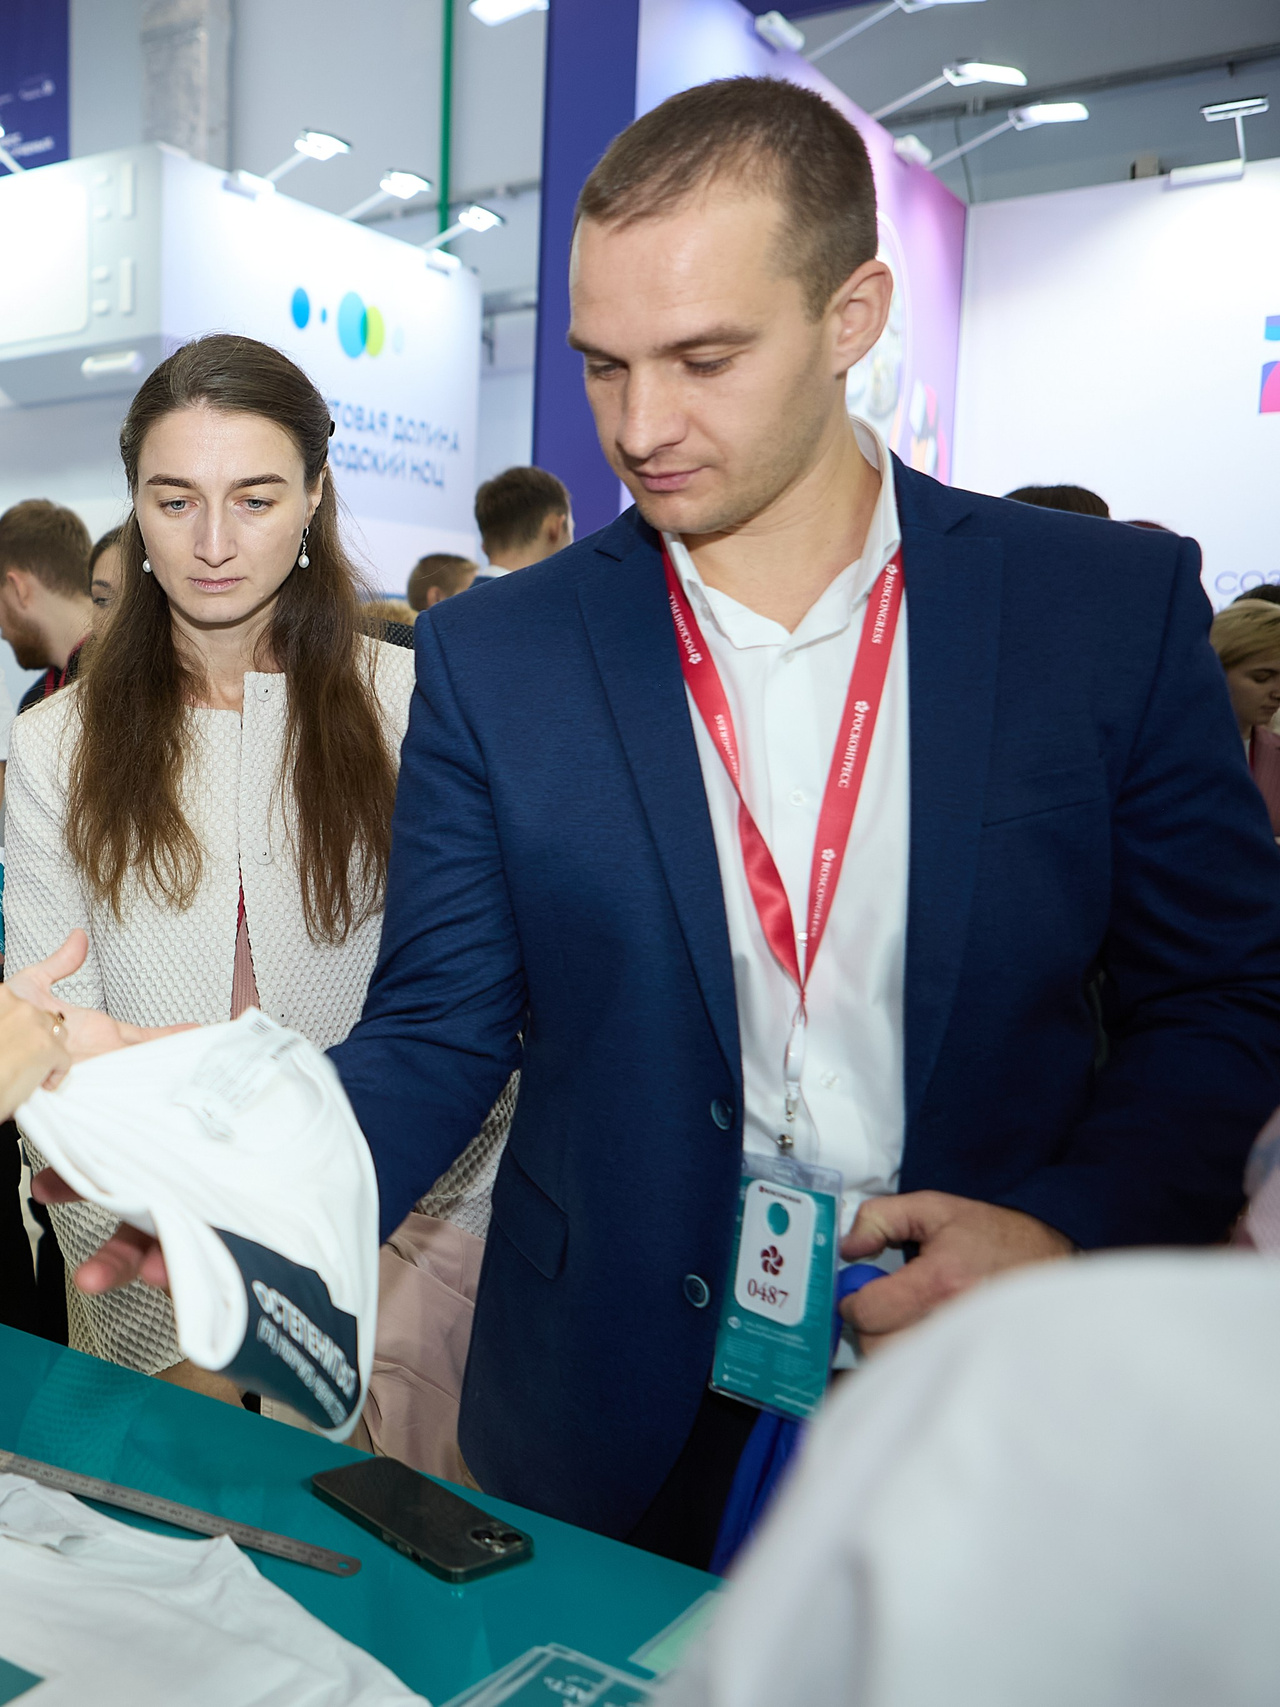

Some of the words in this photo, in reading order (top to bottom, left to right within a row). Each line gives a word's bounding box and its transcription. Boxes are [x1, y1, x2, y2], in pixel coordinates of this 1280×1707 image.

[393, 415, 459, 453] ДОЛИНА
[329, 441, 406, 476] ОДСКИЙ
[410, 459, 444, 489] НОЦ
[871, 574, 899, 645] ROSCONGRESS
[838, 711, 868, 789] РОСКОНГРЕСС
[810, 861, 838, 938] ROSCONGRESS
[747, 1279, 790, 1309] 0487
